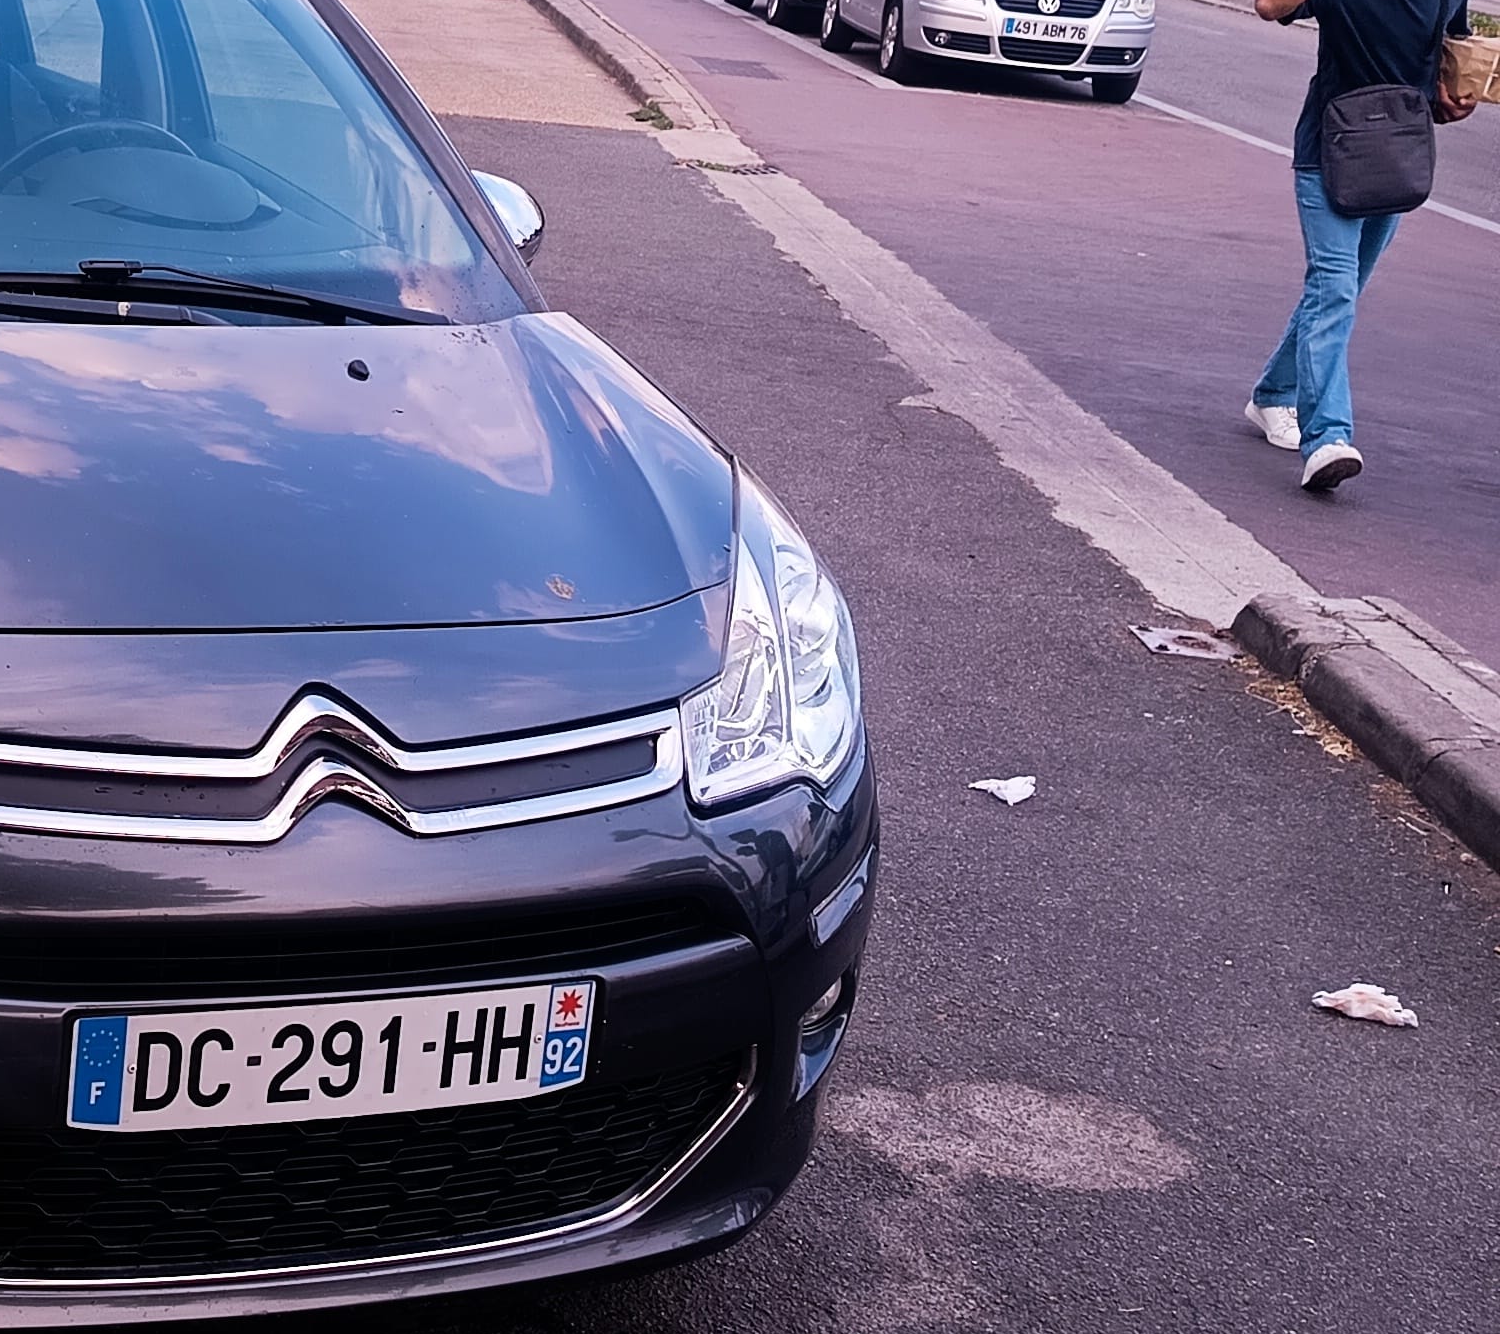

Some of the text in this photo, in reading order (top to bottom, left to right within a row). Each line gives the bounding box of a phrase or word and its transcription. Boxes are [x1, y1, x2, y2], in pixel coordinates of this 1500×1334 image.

[1014, 20, 1087, 41] 491 ABM 76
[133, 1003, 536, 1113] DC-291-HH
[544, 1036, 583, 1075] 92
[89, 1081, 106, 1105] F
